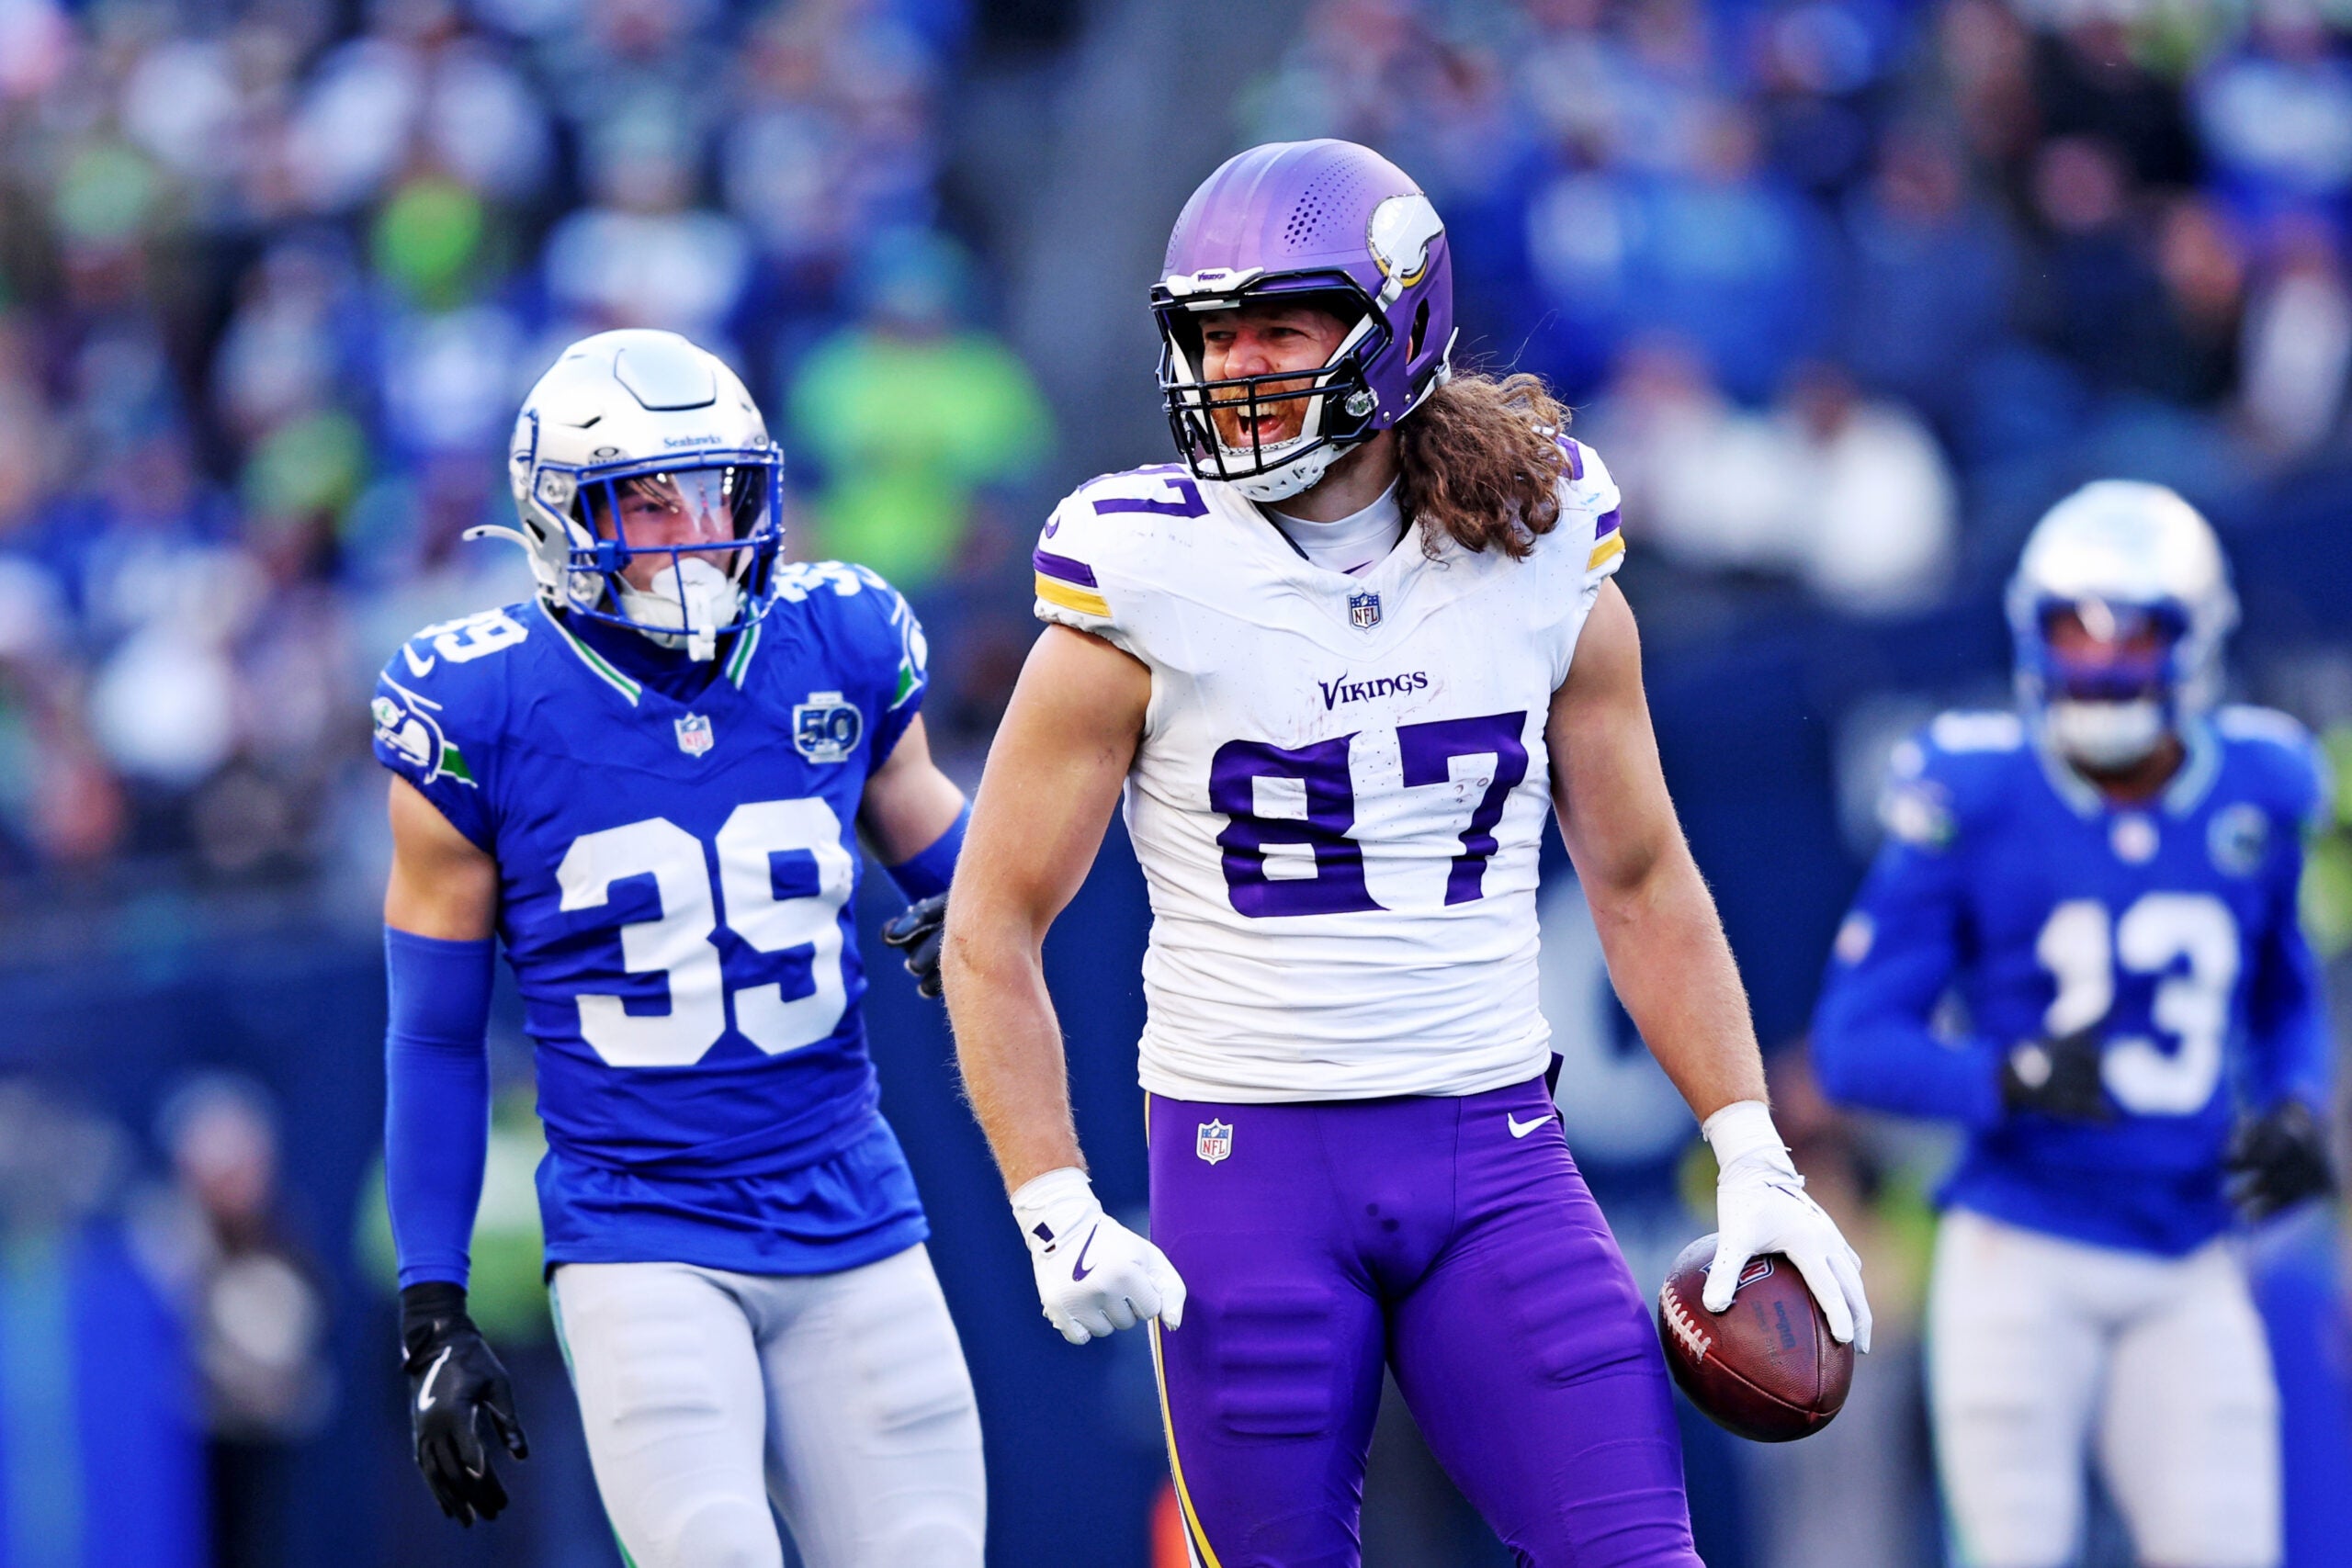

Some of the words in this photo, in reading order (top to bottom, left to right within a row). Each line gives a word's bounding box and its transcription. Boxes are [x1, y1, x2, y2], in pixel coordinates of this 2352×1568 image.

[663, 434, 722, 448] Seahawks
[1353, 607, 1378, 625] NFL
[799, 707, 859, 752] 50
[1209, 709, 1529, 919] 87
[555, 796, 854, 1067] 39
[2034, 890, 2243, 1118] 13
[1203, 1139, 1226, 1156] NFL
